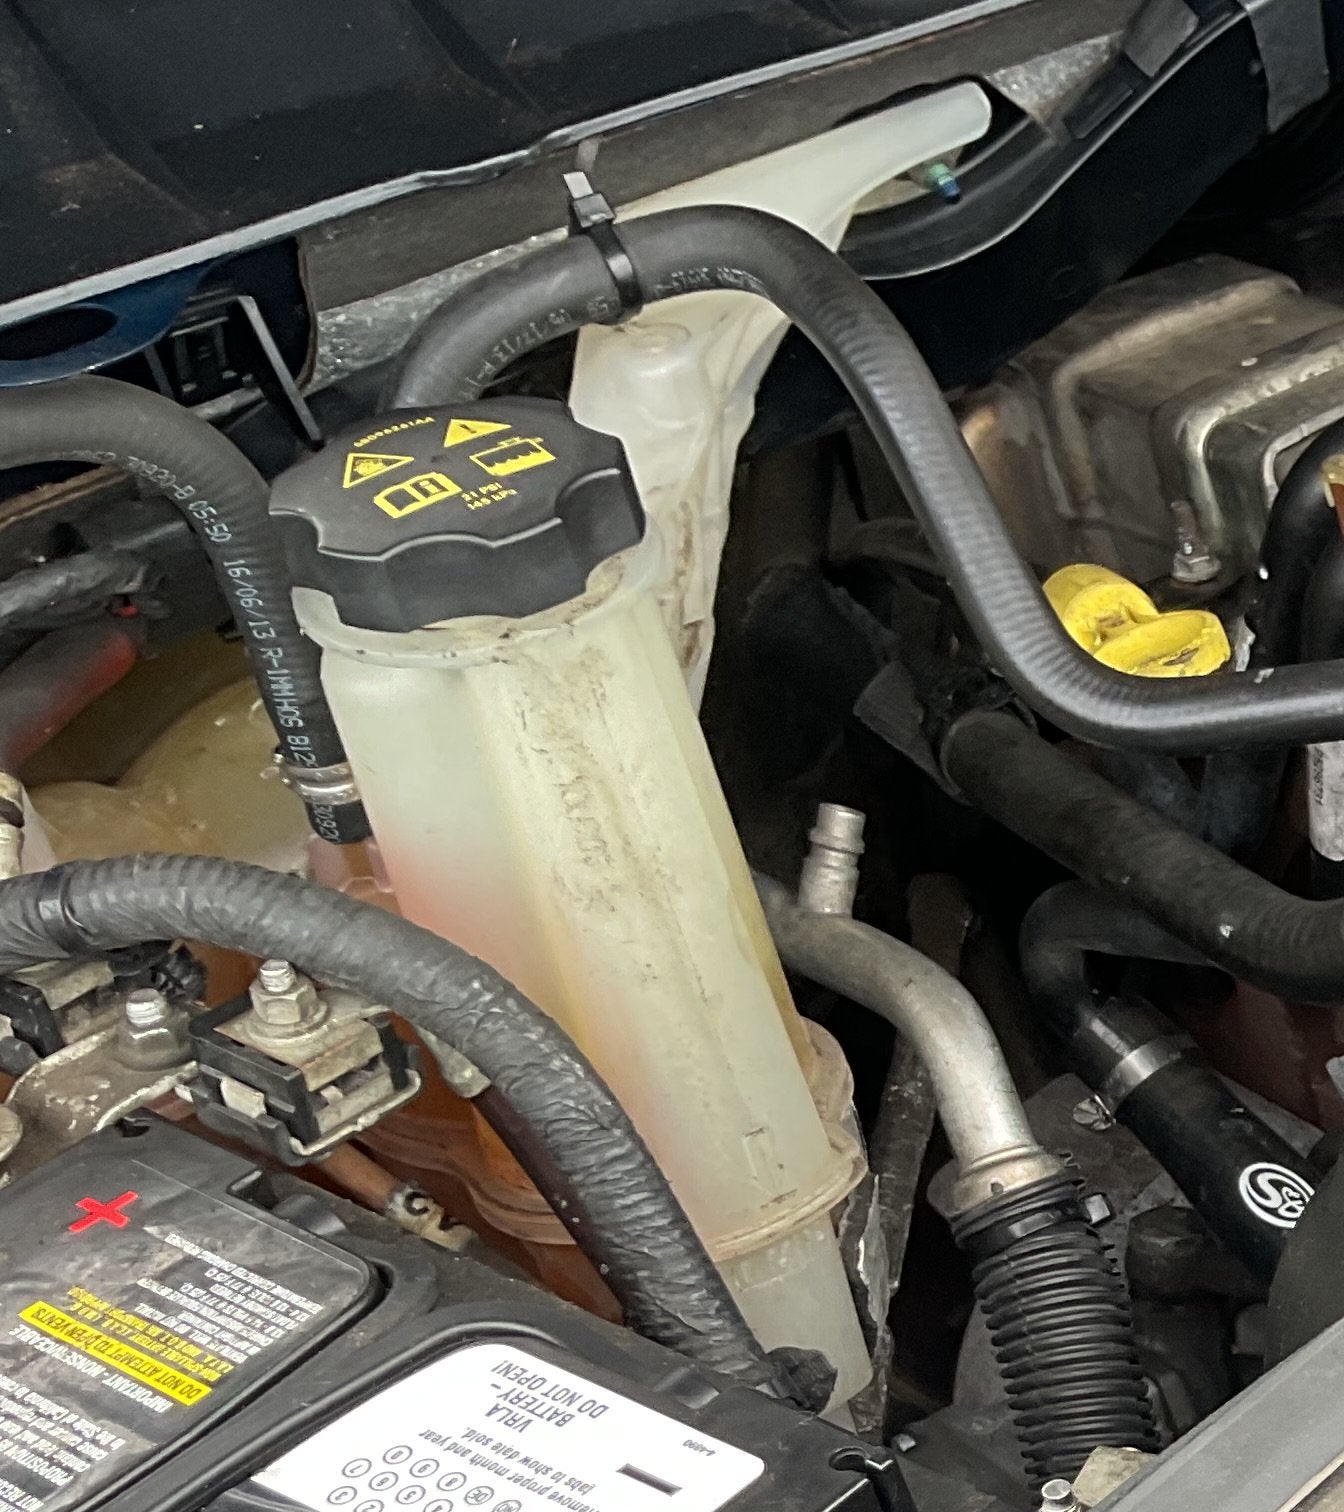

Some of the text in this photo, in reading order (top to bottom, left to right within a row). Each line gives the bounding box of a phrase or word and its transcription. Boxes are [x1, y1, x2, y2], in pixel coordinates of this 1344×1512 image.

[188, 500, 233, 543] 05:50
[222, 559, 276, 641] 16/06/13
[62, 1324, 101, 1346] OPEN
[88, 1338, 115, 1354] TO
[6, 1323, 107, 1378] NONSERVICEABLE
[103, 1345, 163, 1379] ATTEMPT
[100, 1371, 174, 1413] IMPORTANT
[152, 1370, 186, 1391] NOT
[176, 1382, 203, 1400] DO
[487, 1359, 612, 1419] DO NOT OPEN!
[479, 1402, 538, 1433] VRLA
[494, 1385, 577, 1427] BATTERY
[415, 1426, 455, 1447] year
[440, 1441, 474, 1459] and
[454, 1426, 596, 1496] tabs to show date sold.
[464, 1452, 513, 1478] month
[505, 1469, 555, 1496] proper
